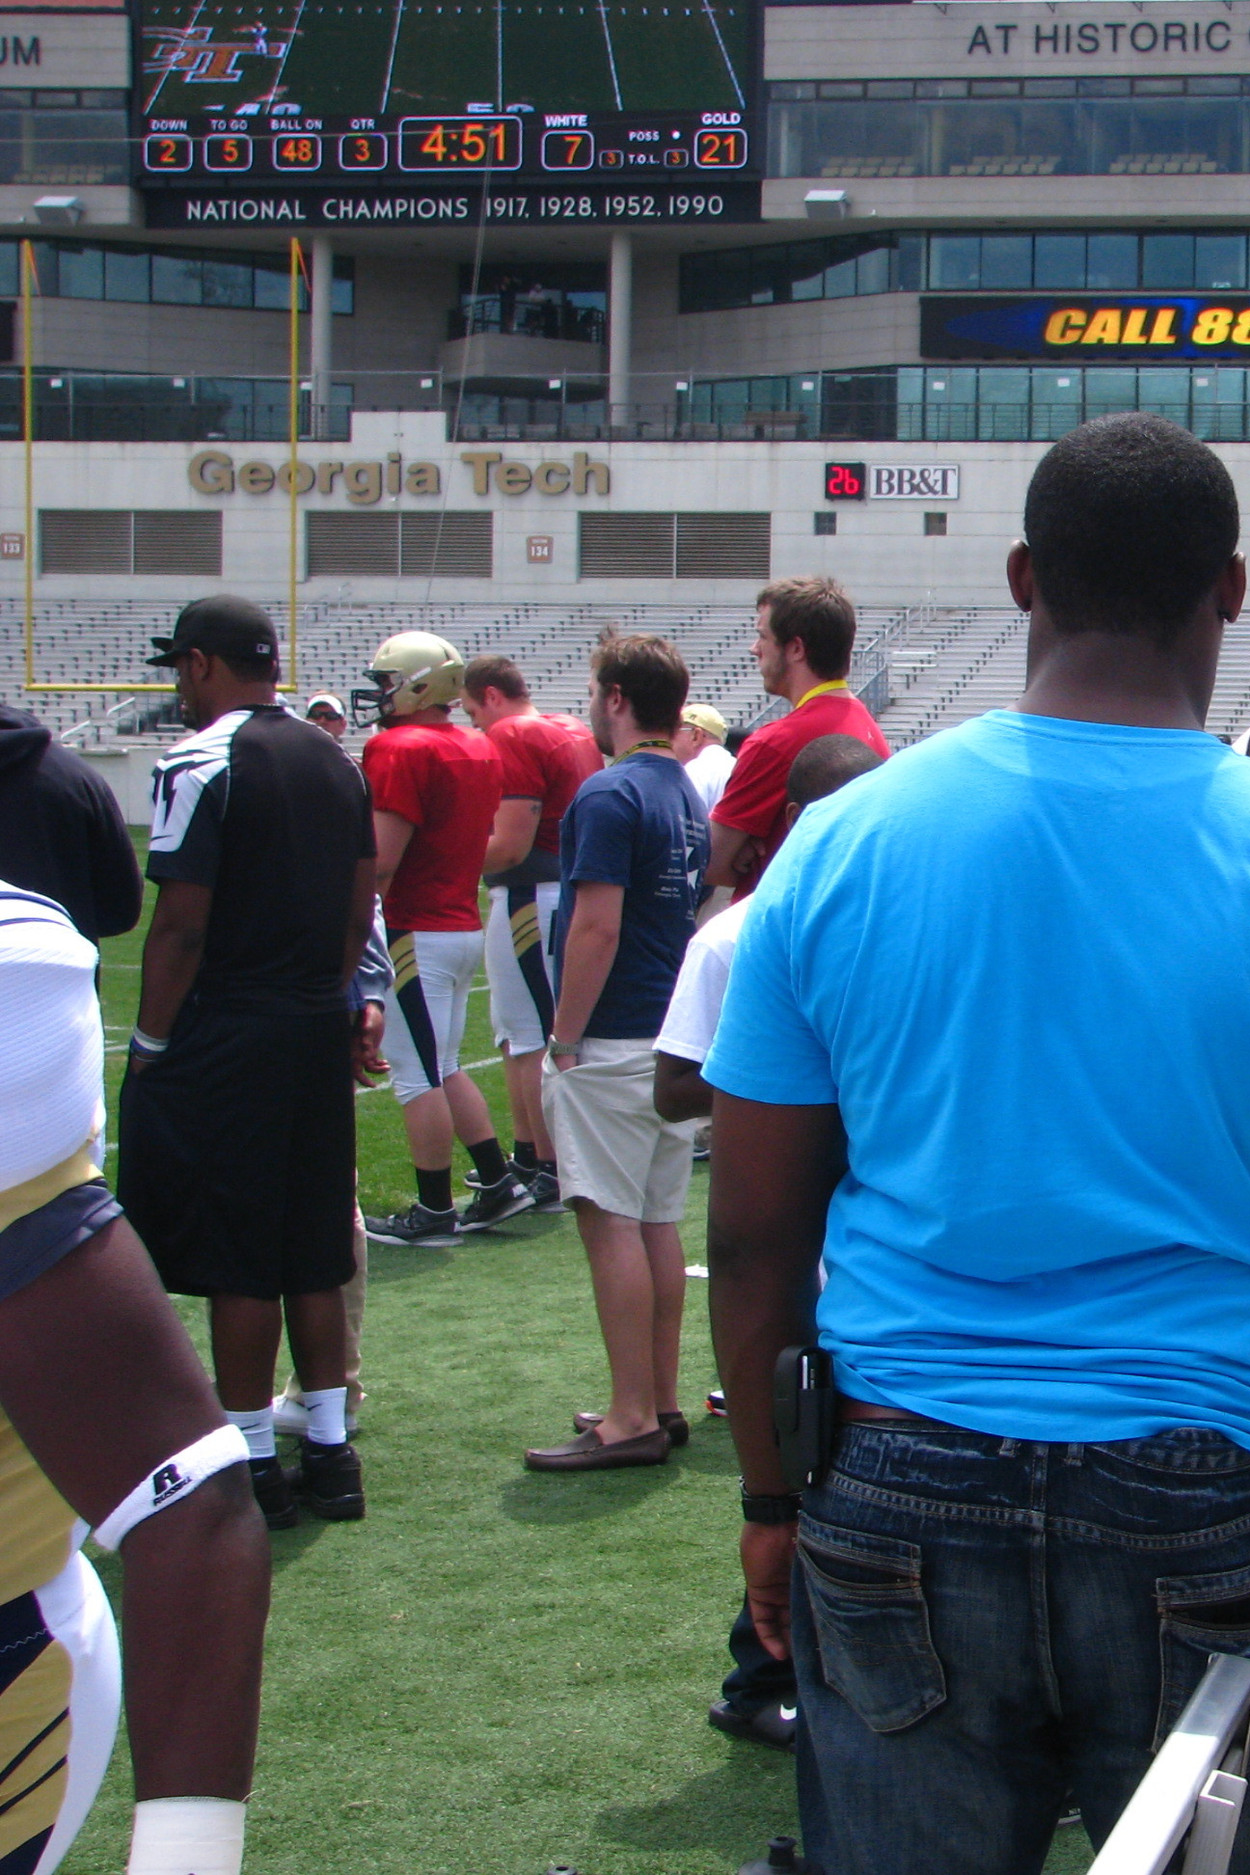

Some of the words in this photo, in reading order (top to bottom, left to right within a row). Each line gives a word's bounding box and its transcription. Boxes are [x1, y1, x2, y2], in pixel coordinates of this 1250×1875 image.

[967, 24, 1018, 55] AT
[1033, 21, 1232, 54] HISTORIC
[151, 119, 188, 131] DOWN
[210, 119, 228, 131] TO
[230, 119, 248, 131] GO
[270, 118, 302, 130] BALL
[305, 118, 323, 130] ON
[350, 118, 375, 130] QTR
[544, 114, 589, 128] WHITE
[701, 112, 741, 126] GOLD
[420, 123, 507, 162] 4:51
[628, 131, 660, 142] POSS
[701, 134, 737, 163] 21
[159, 139, 177, 163] 2
[222, 139, 239, 163] 5
[281, 139, 313, 162] 48
[354, 138, 371, 162] 3
[563, 135, 583, 164] 7
[187, 200, 307, 220] NATIONAL
[322, 198, 469, 219] CHAMPIONS
[668, 195, 724, 216] 1990
[1043, 308, 1177, 345] CALL
[188, 450, 442, 504] Georgia
[460, 452, 611, 496] Tech
[874, 468, 956, 496] BB&T
